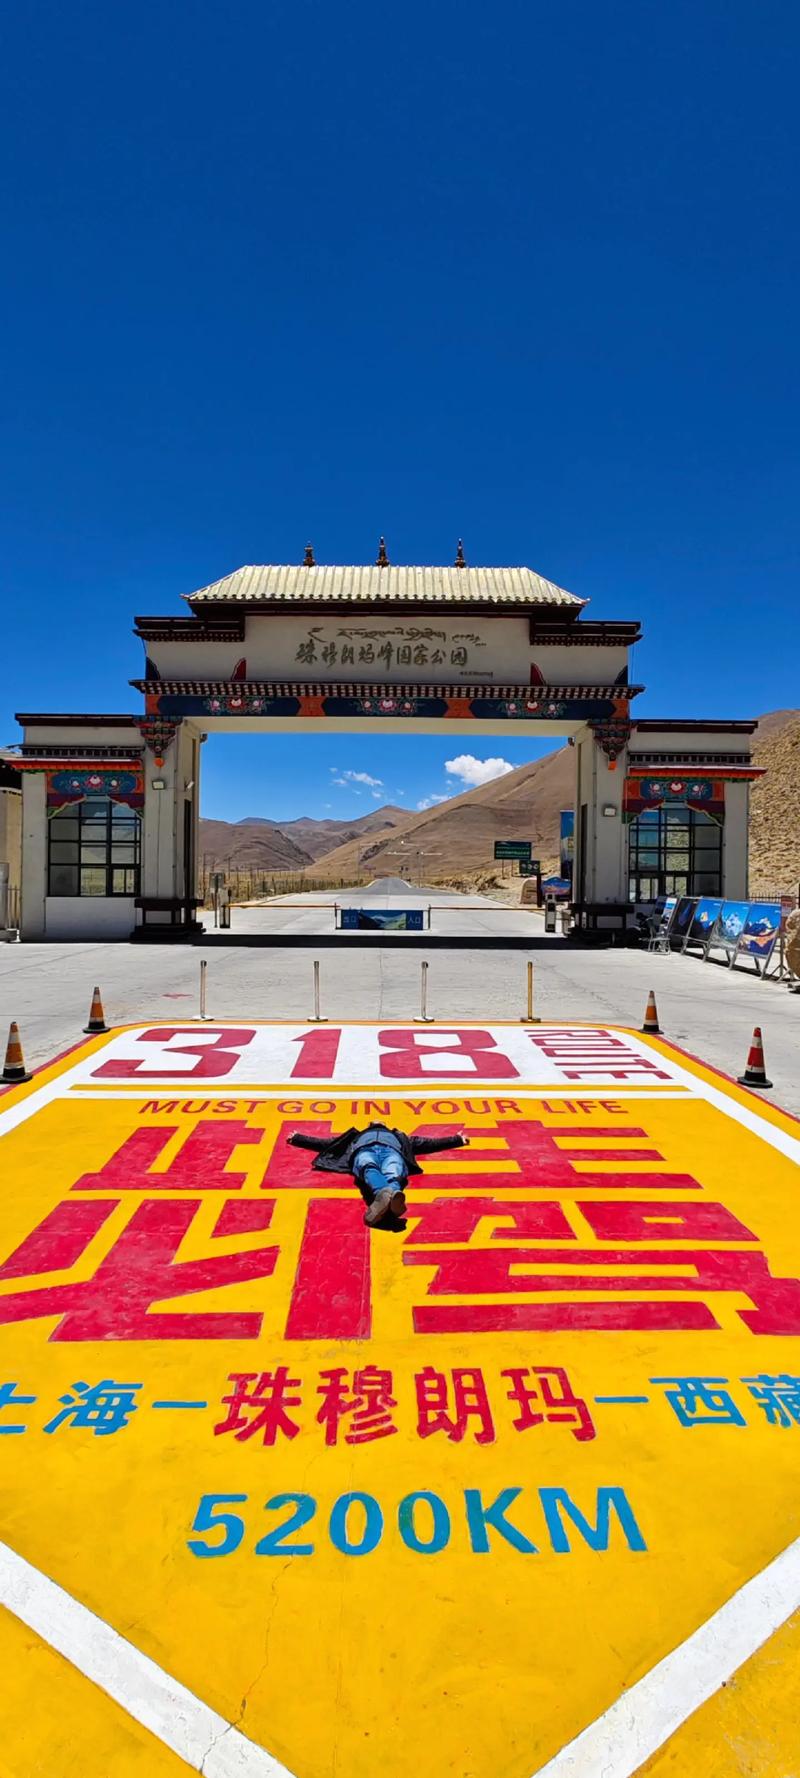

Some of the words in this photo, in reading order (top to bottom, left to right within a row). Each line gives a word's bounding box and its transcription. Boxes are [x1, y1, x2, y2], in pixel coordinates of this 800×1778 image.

[90, 1027, 520, 1079] 318
[524, 1029, 674, 1080] ROUTE
[138, 1100, 267, 1114] MUST
[276, 1101, 337, 1114] GO
[351, 1101, 391, 1115] IN
[404, 1100, 523, 1115] YOUR
[541, 1100, 629, 1114] LIFE
[186, 1487, 648, 1558] 5200KM
